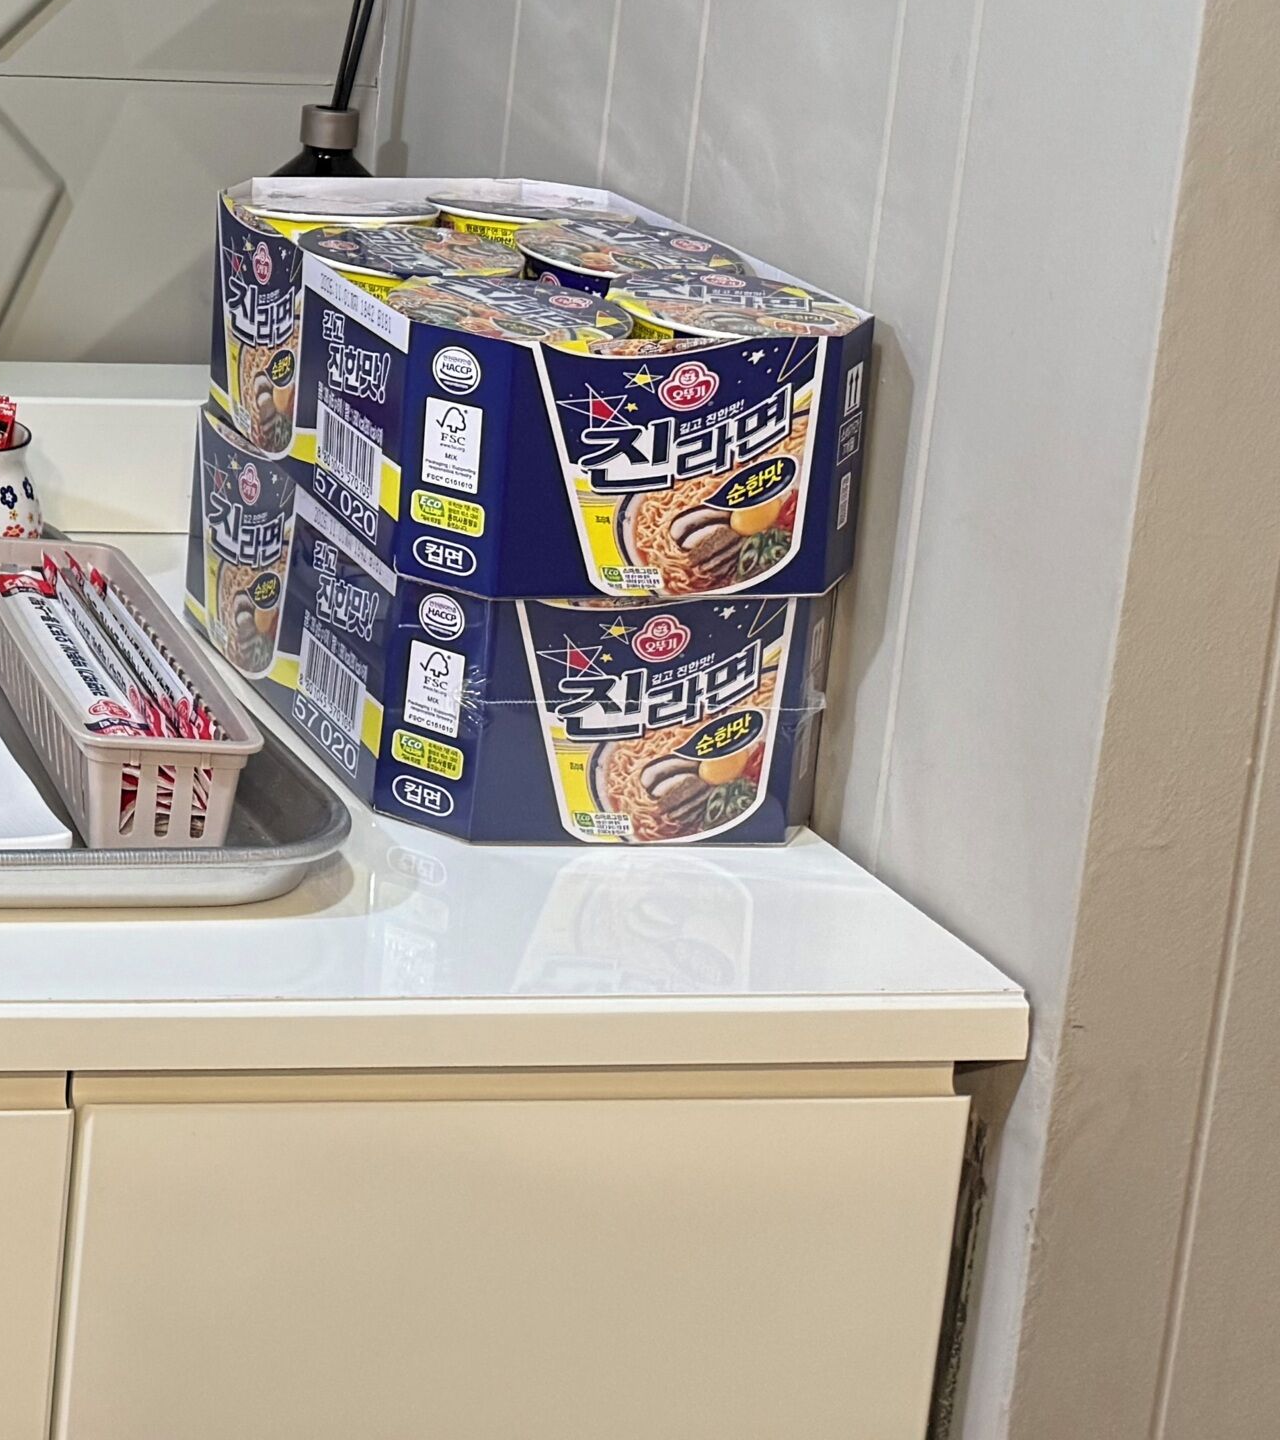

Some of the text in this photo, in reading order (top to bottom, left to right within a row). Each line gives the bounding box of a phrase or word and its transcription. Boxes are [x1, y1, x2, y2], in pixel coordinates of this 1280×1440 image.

[227, 276, 295, 348] 진라면
[322, 309, 345, 343] 깊고
[328, 343, 390, 404] 진한맛!
[442, 362, 473, 375] HACCP
[672, 385, 706, 402] 오뚜기
[680, 398, 745, 435] 깊고 진한맛!
[440, 432, 466, 447] FSC
[578, 384, 791, 494] 진라면
[726, 461, 784, 506] 순한맛
[315, 469, 376, 537] 57 020
[420, 496, 442, 508] ECO
[207, 492, 285, 569] 진라면
[313, 540, 338, 576] 깊고
[425, 542, 463, 570] 컵면
[316, 574, 379, 642] 진한맛!
[428, 607, 457, 622] HACCP
[645, 638, 677, 653] 오뚜기
[424, 676, 448, 691] FSC
[556, 638, 762, 743] 진라면
[295, 695, 356, 770] 57 020
[401, 736, 422, 749] ECO
[695, 713, 752, 757] 순한맛
[404, 781, 441, 810] 컵면
